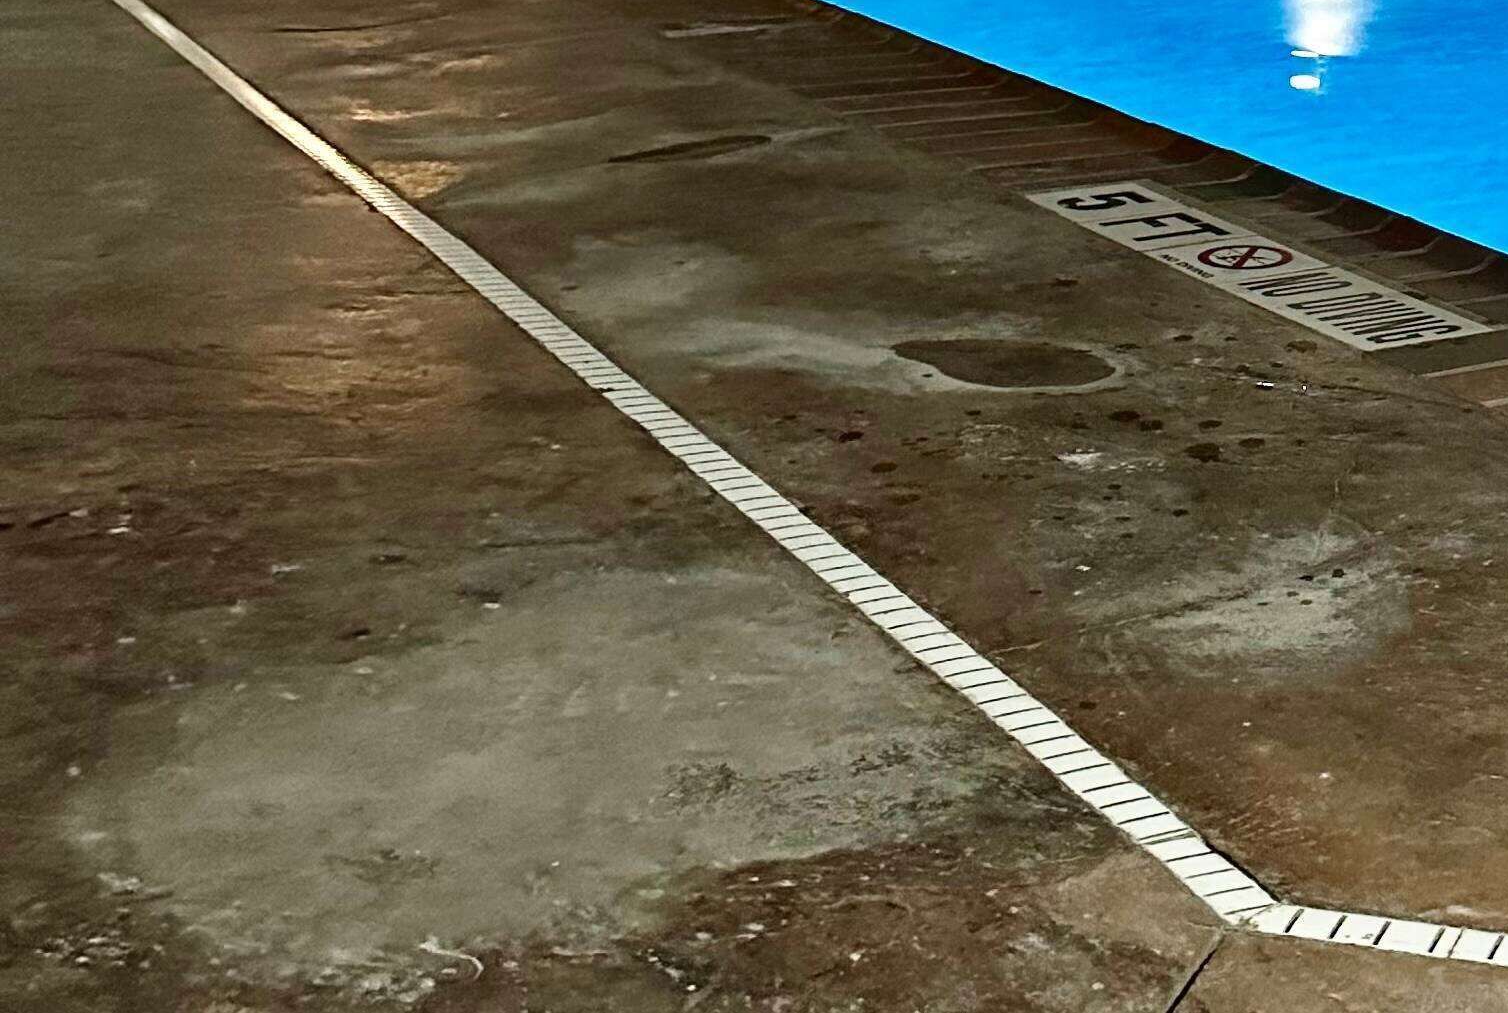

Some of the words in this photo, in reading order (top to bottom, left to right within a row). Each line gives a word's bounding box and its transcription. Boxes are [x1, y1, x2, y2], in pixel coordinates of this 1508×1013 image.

[1057, 191, 1155, 211] 5
[1099, 212, 1232, 241] FT
[1237, 272, 1353, 297] NO
[1285, 292, 1462, 343] DIVING
